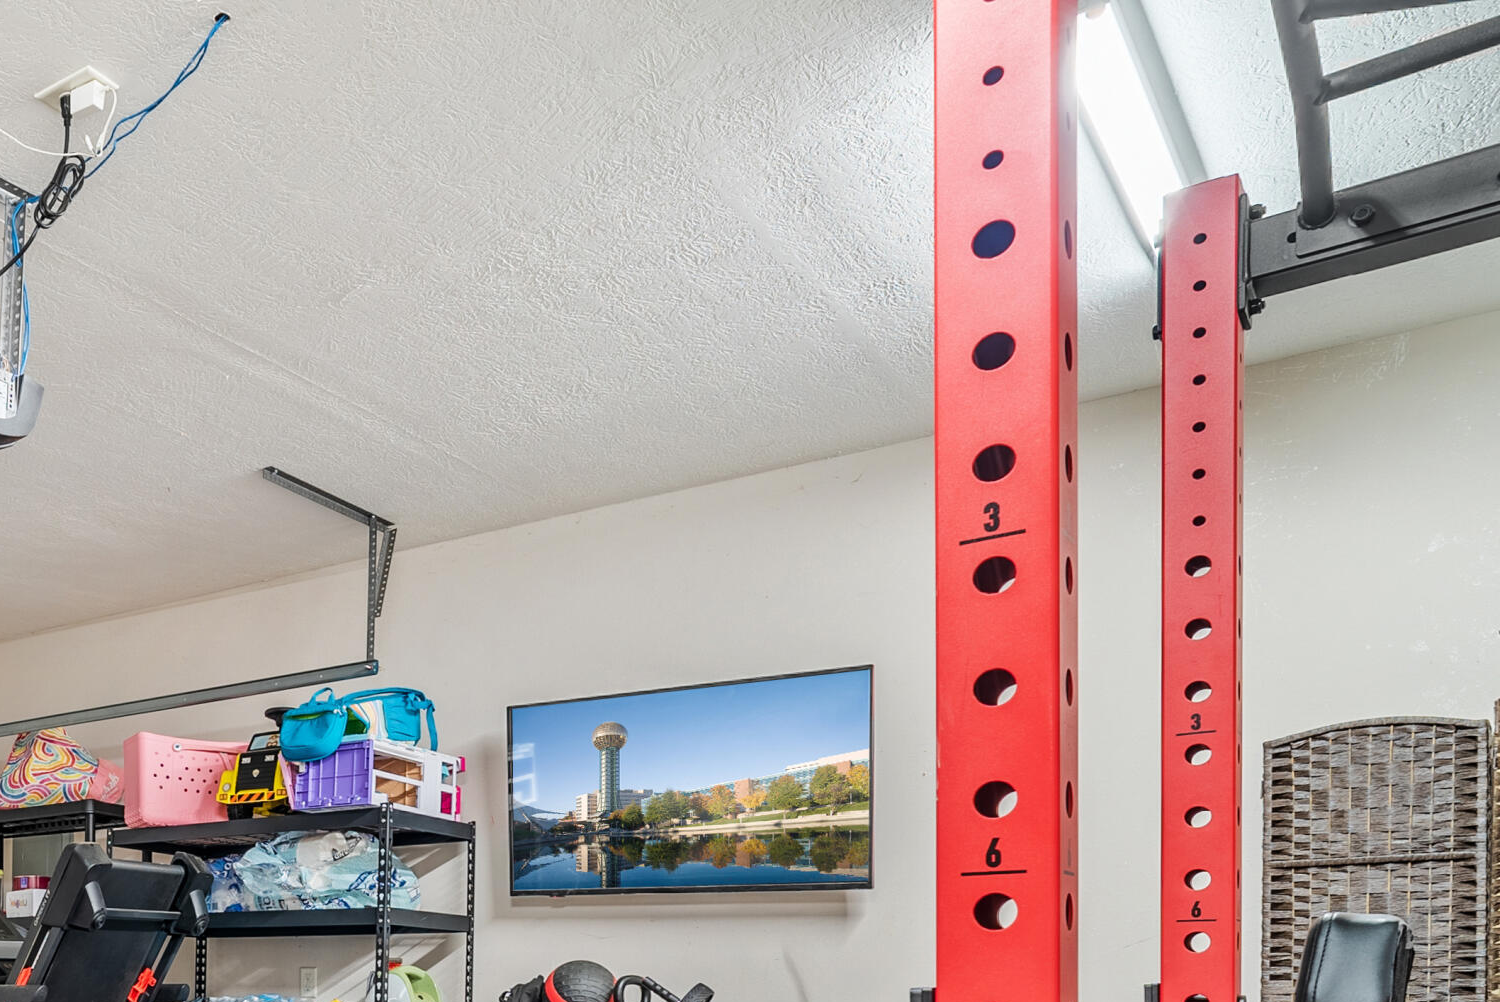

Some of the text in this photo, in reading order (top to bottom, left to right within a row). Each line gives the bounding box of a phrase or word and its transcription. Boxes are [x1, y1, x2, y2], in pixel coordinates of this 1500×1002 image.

[983, 502, 1001, 532] 3
[1190, 713, 1201, 731] 3
[985, 837, 1002, 868] 6
[1190, 901, 1202, 918] 6
